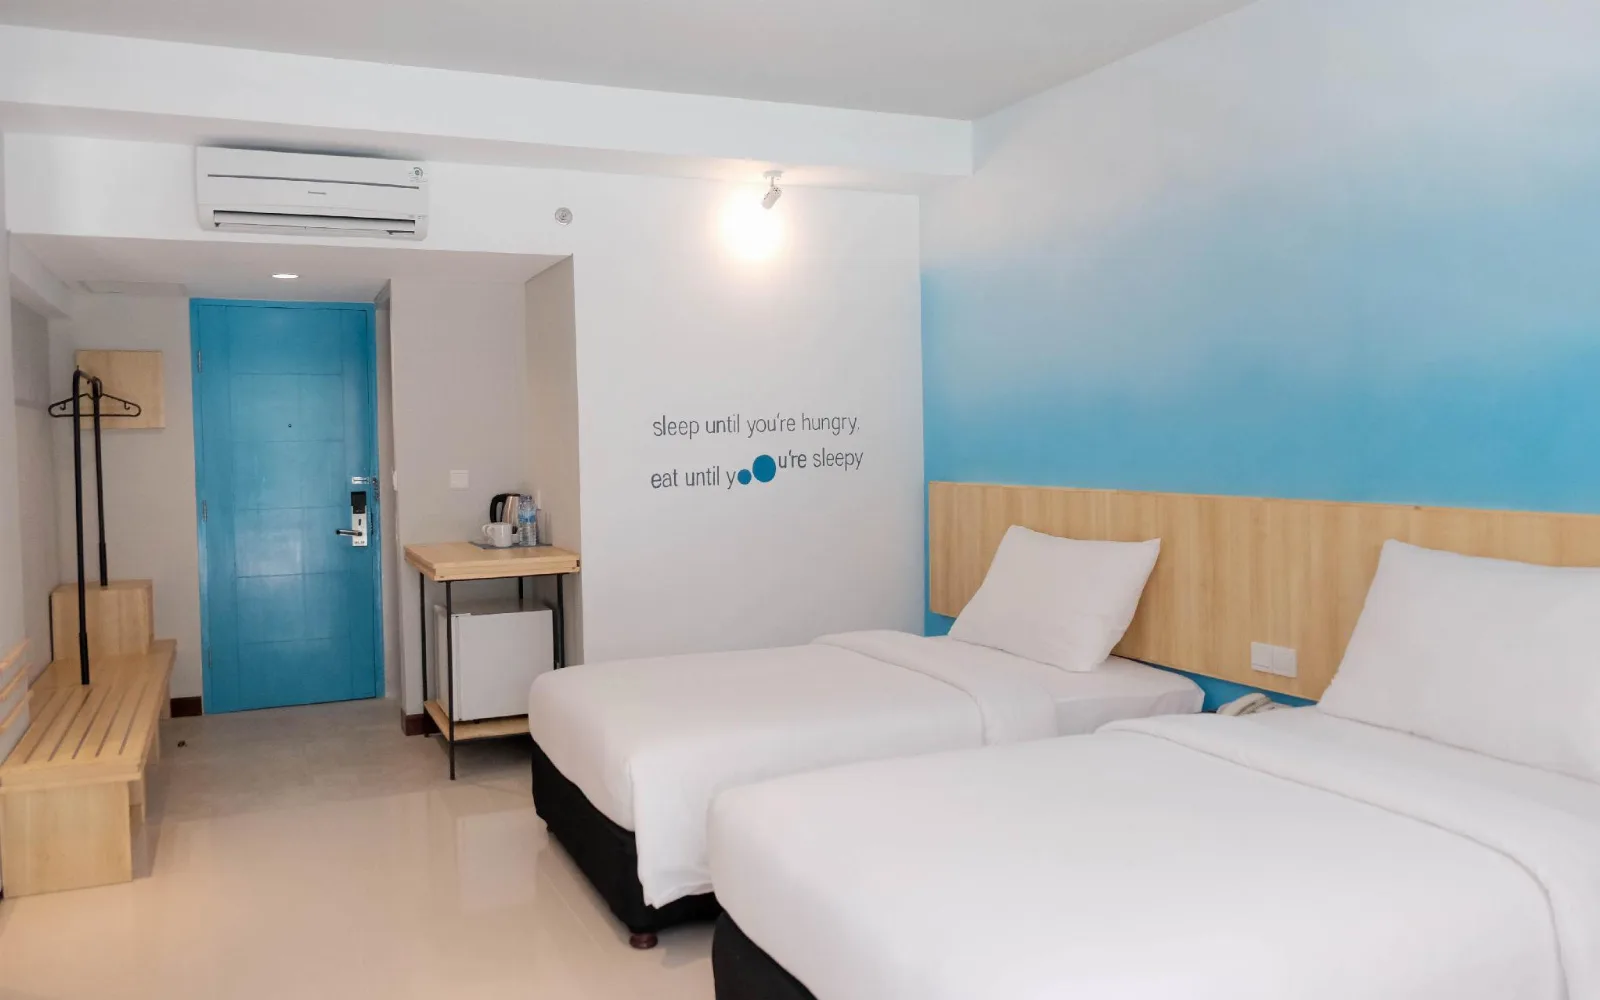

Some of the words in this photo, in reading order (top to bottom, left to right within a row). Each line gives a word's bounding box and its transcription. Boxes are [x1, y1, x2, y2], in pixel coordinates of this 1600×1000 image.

[652, 414, 700, 440] sleep
[705, 413, 740, 434] until
[746, 412, 796, 438] you're
[801, 412, 860, 436] hungry,
[650, 468, 679, 489] eat
[685, 465, 720, 487] until
[812, 446, 864, 471] sleepy
